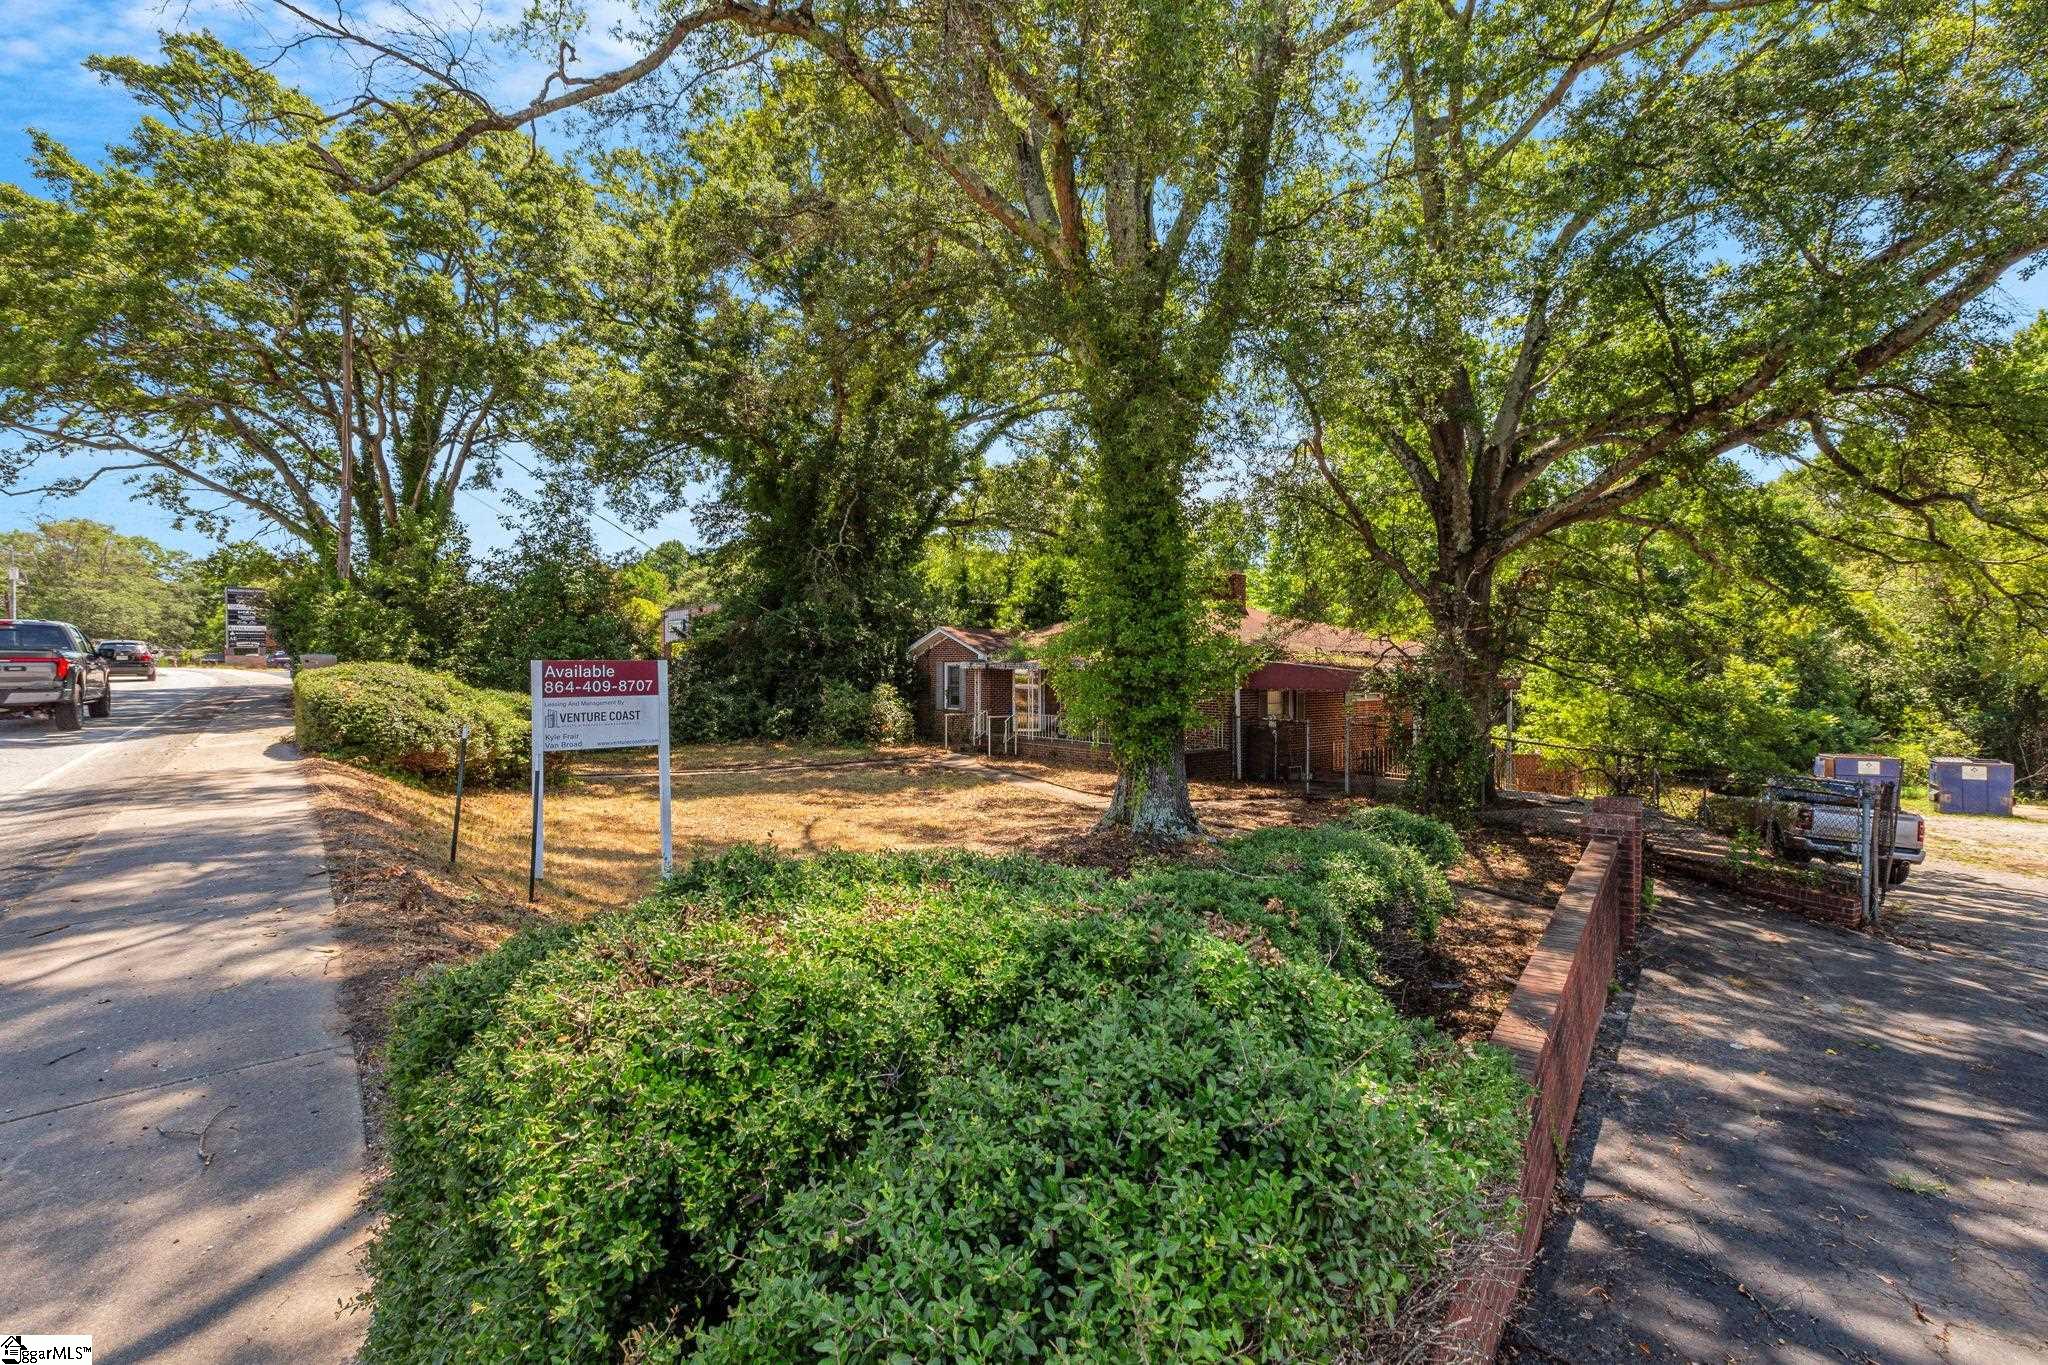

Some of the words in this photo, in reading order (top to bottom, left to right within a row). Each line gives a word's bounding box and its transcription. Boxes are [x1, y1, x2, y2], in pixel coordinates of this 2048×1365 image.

[544, 665, 615, 678] Available
[544, 680, 653, 693] 864-409-8707
[560, 712, 607, 722] VENTURE
[609, 711, 641, 720] COAST
